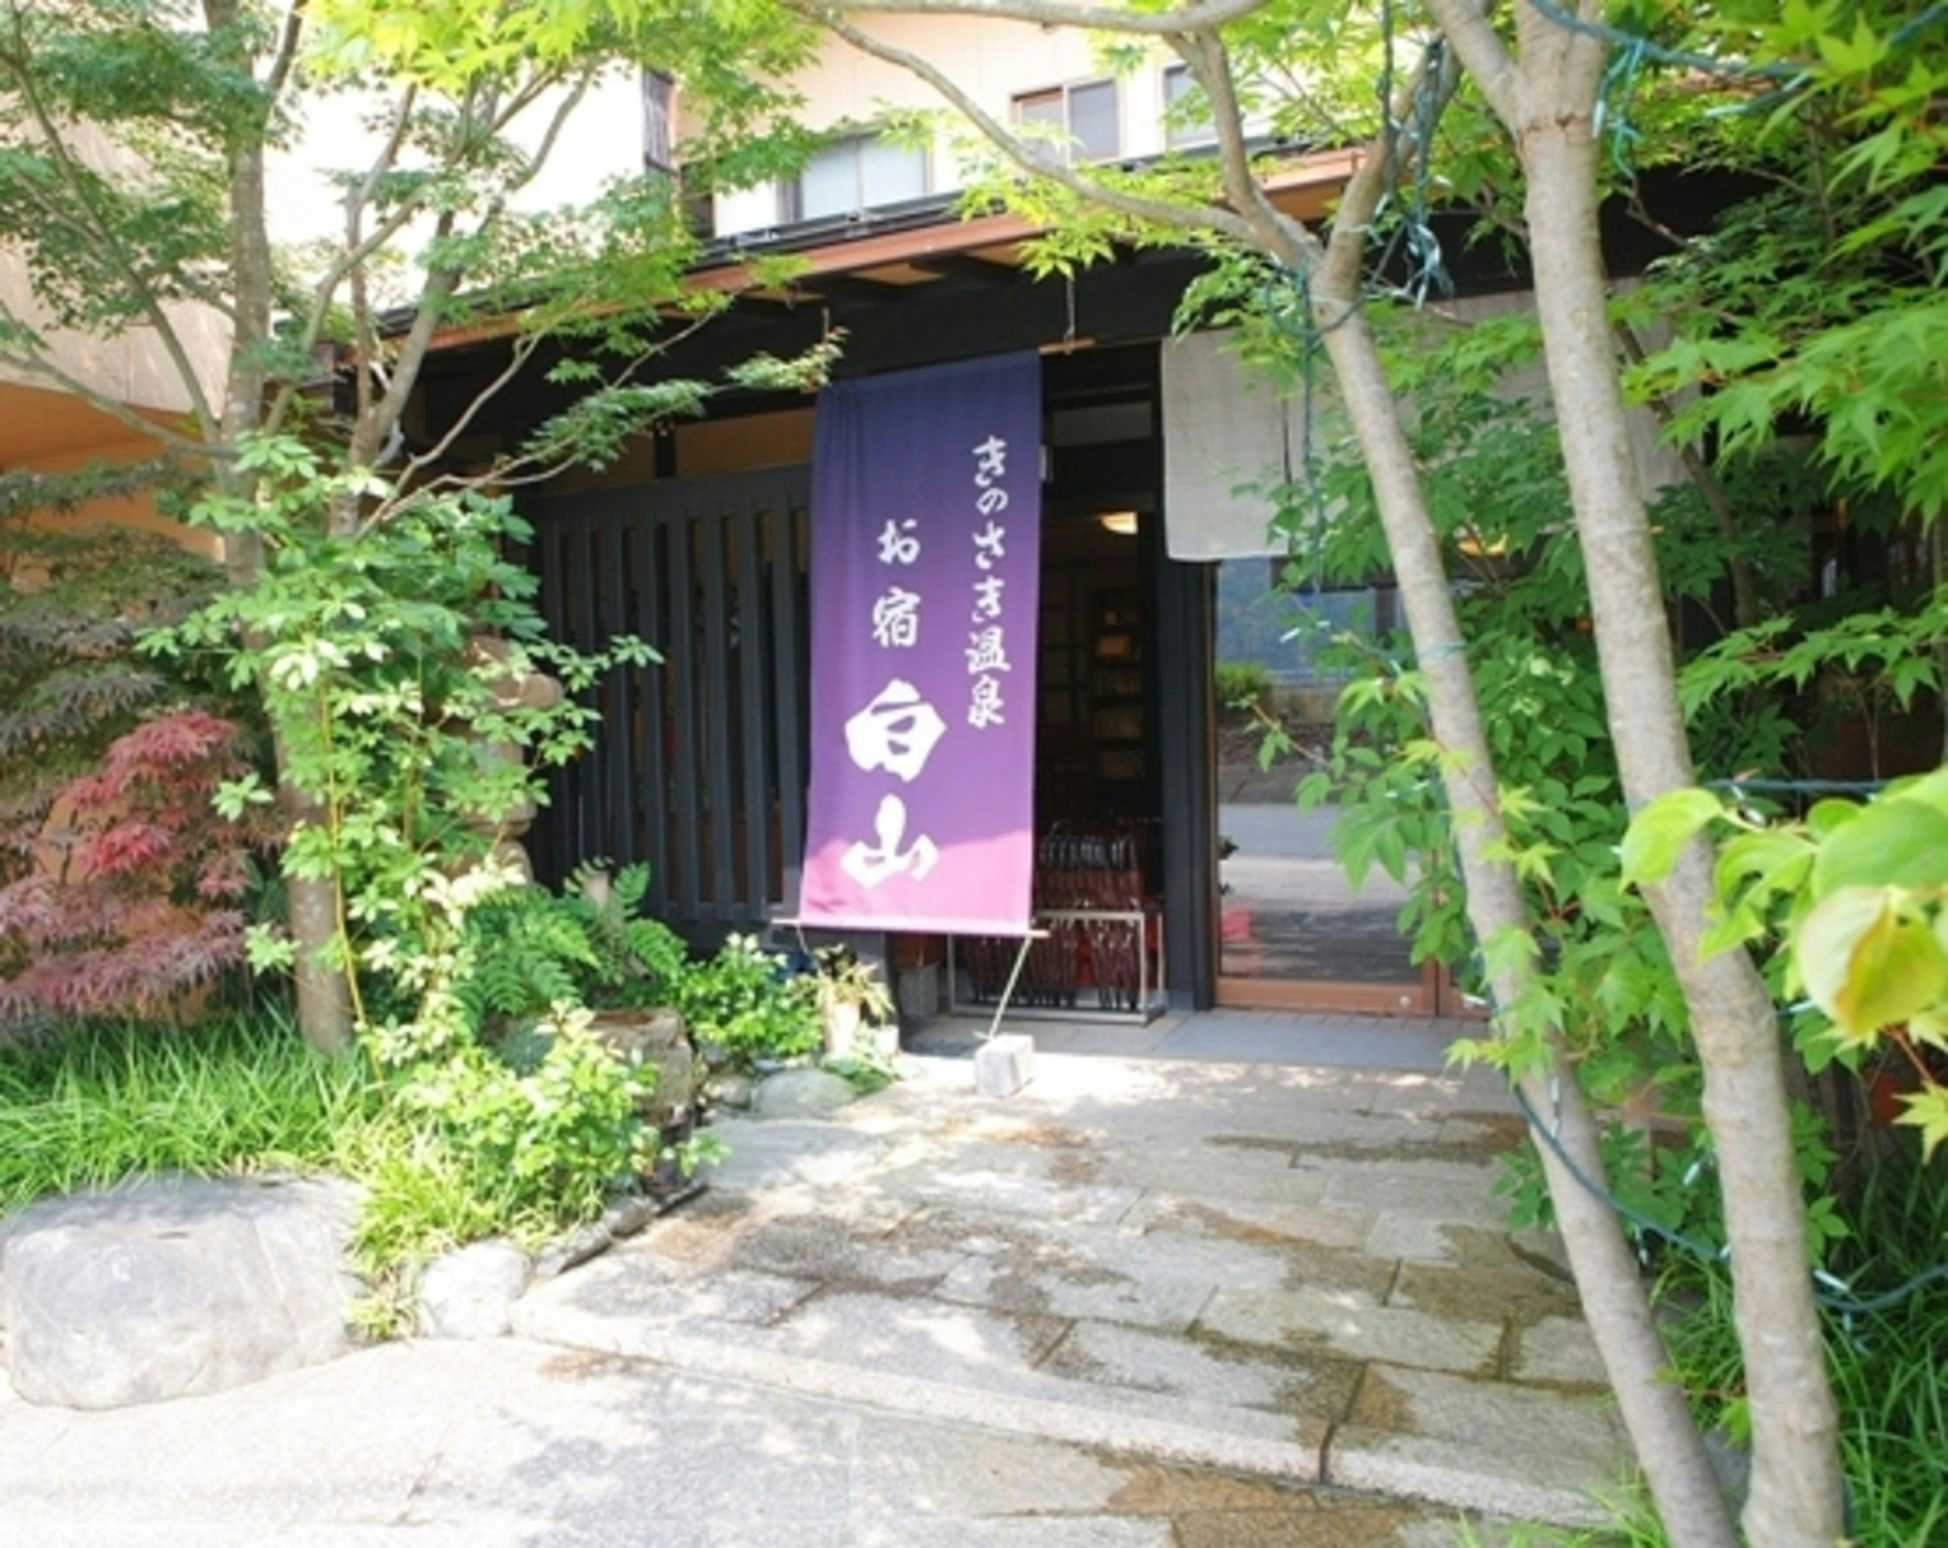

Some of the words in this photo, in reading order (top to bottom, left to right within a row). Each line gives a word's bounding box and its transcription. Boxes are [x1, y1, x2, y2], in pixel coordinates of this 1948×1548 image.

[964, 434, 1012, 730] きのさき温泉
